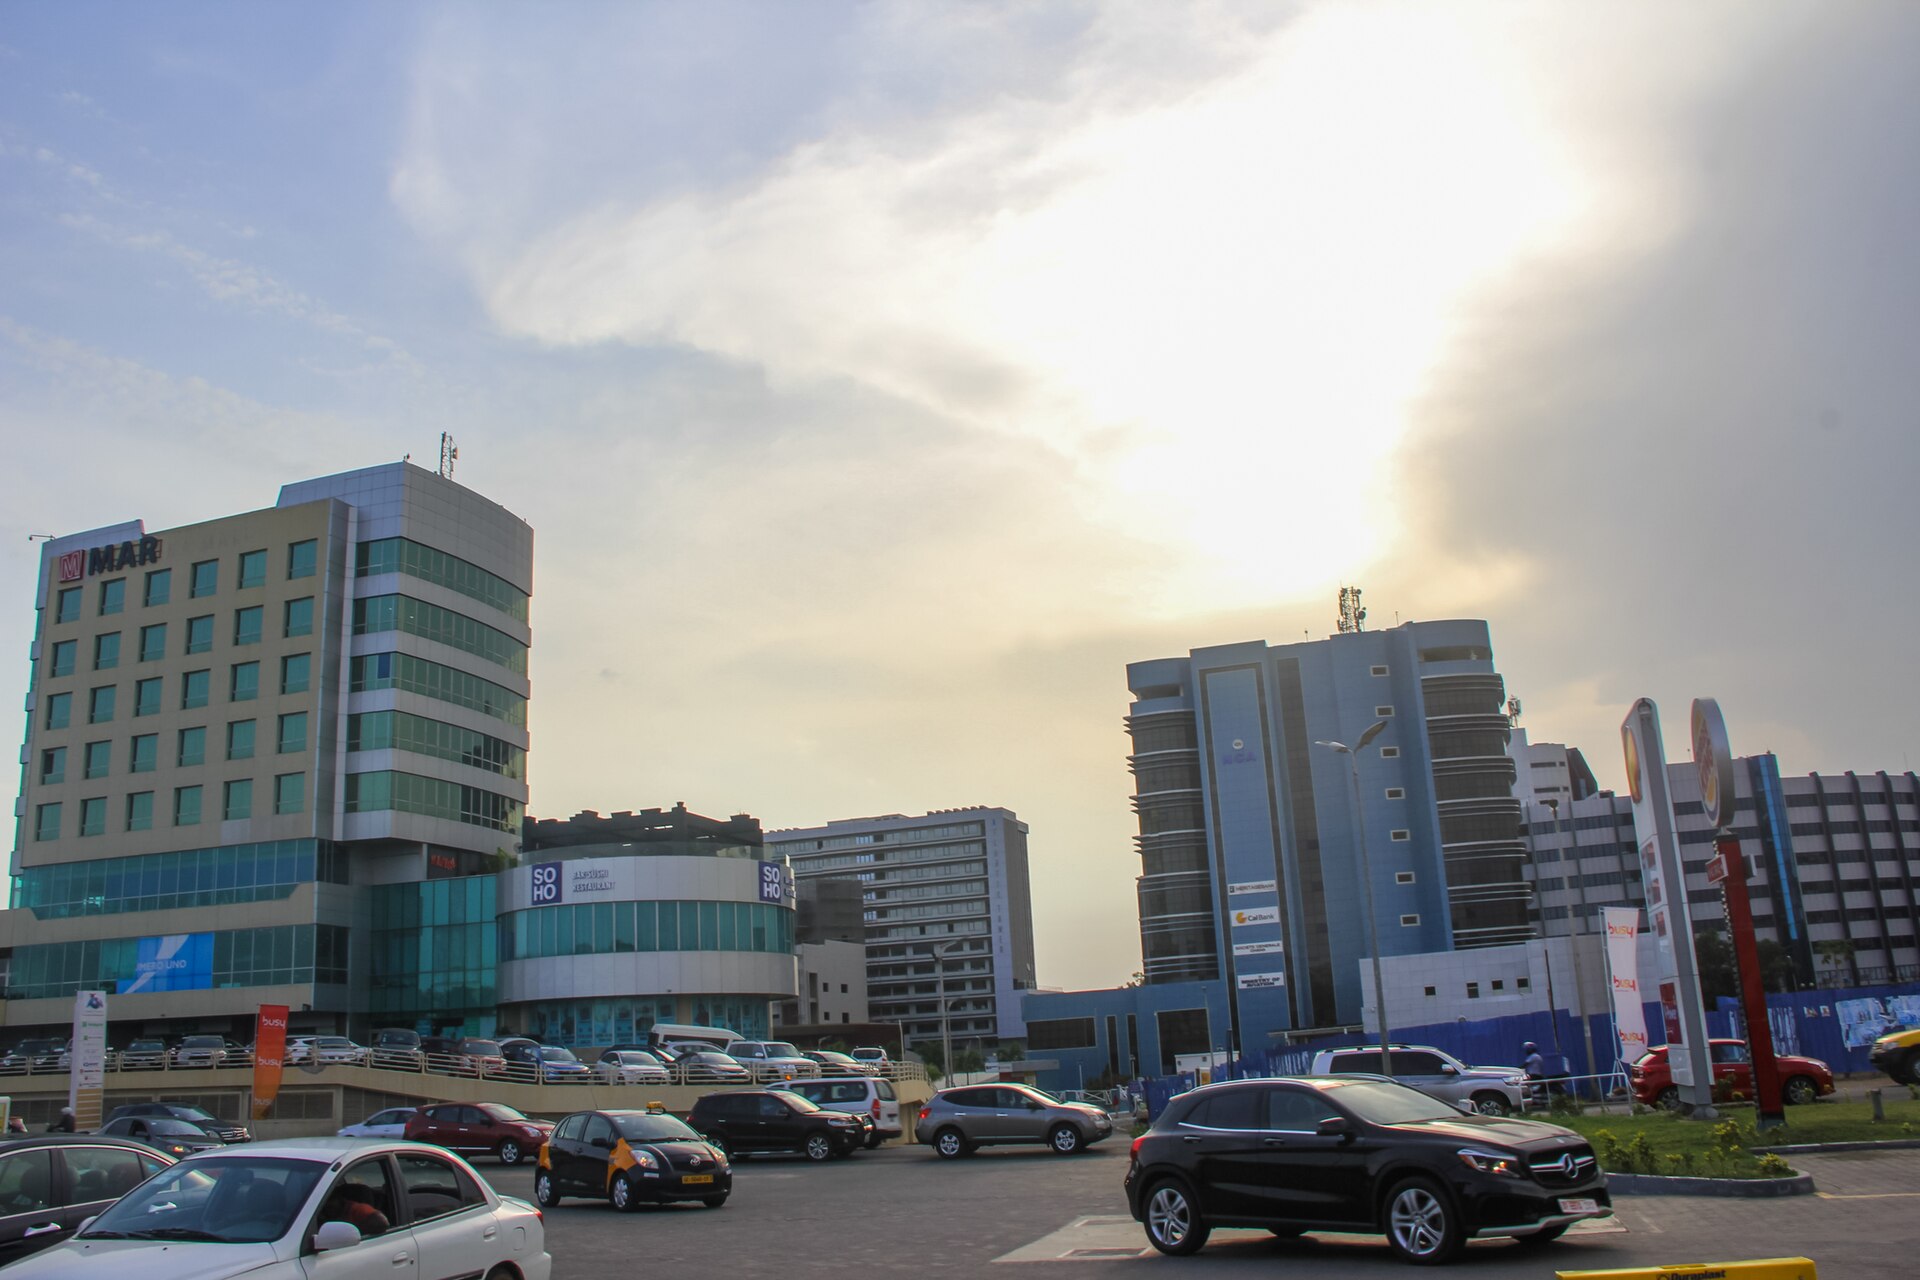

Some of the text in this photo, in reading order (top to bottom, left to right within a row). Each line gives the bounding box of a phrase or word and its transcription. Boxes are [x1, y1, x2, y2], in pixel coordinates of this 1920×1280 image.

[88, 535, 159, 576] MAR
[534, 867, 557, 885] SO
[763, 866, 780, 883] SO
[534, 884, 557, 902] HO
[763, 882, 780, 899] HO
[1607, 922, 1634, 938] busy
[1613, 974, 1637, 991] busy
[262, 1015, 286, 1029] busy
[1618, 1028, 1645, 1044] busy
[258, 1055, 282, 1069] busy
[1671, 1269, 1726, 1280] Duraplast
